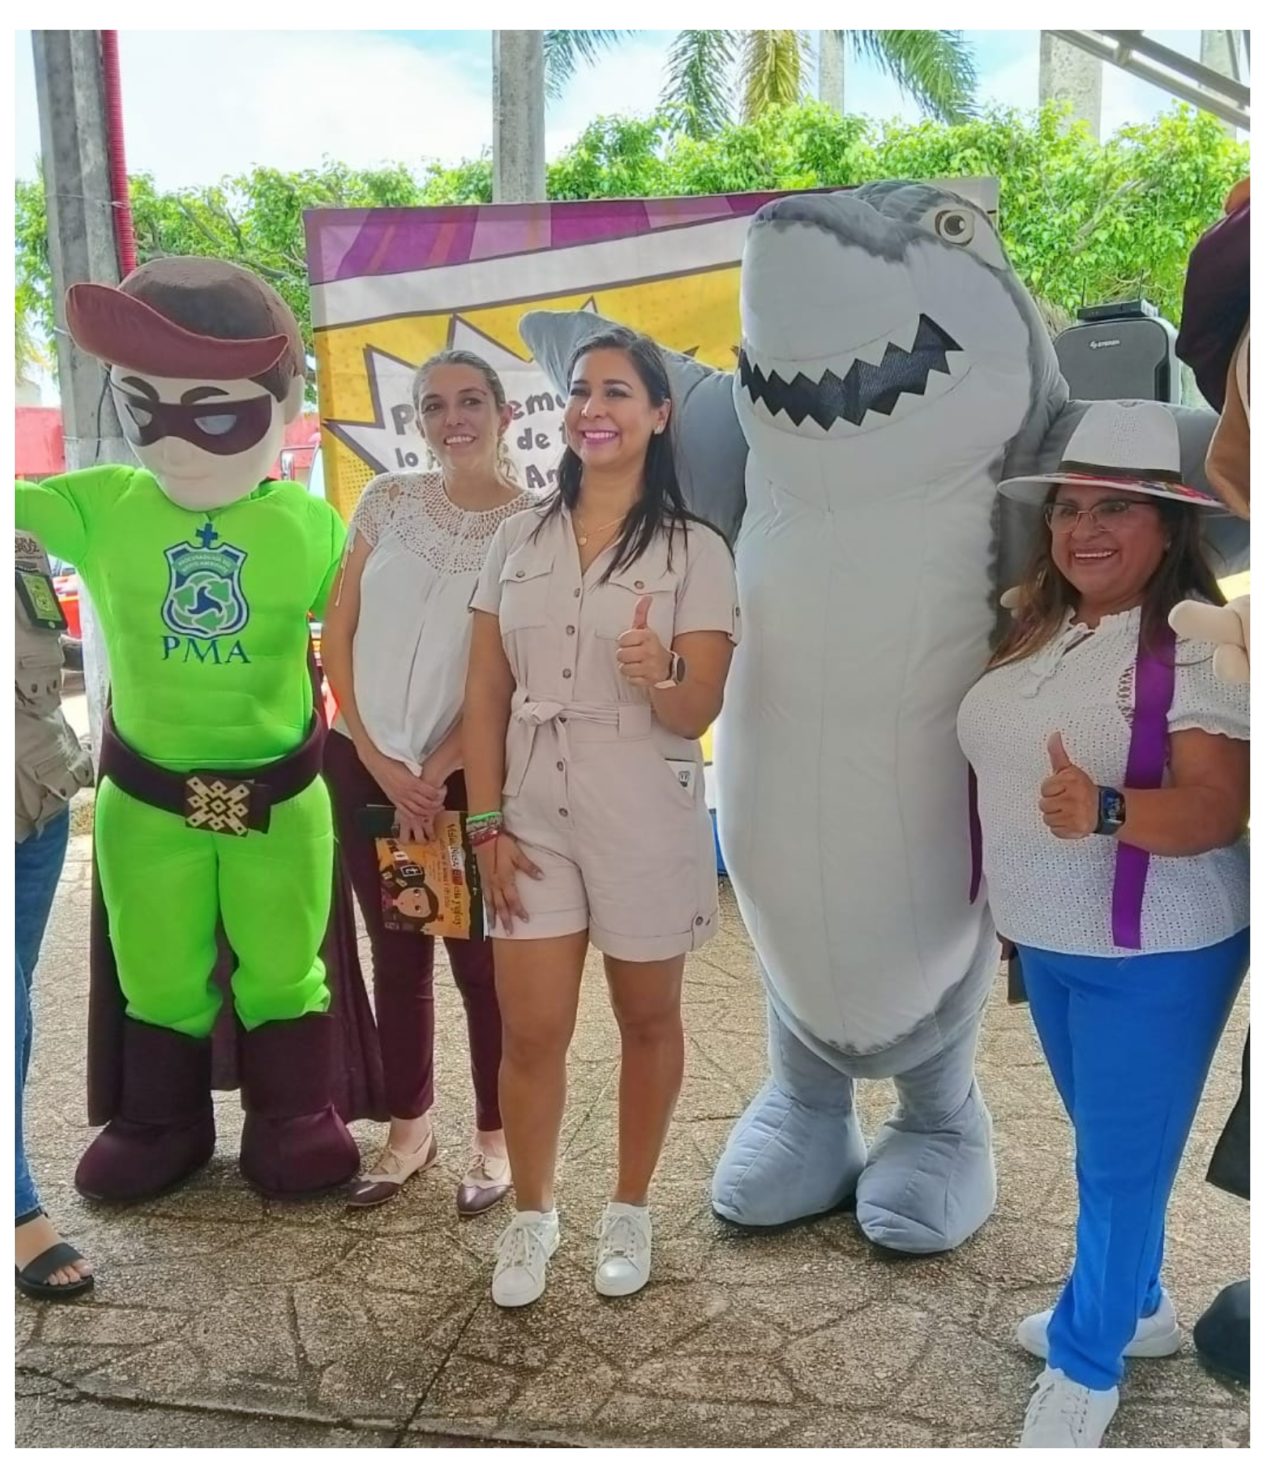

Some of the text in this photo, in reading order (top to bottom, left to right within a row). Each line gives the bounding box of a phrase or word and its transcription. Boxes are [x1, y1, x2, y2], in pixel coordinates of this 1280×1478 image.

[395, 448, 418, 468] lo
[517, 427, 551, 450] de
[161, 635, 252, 664] PMA
